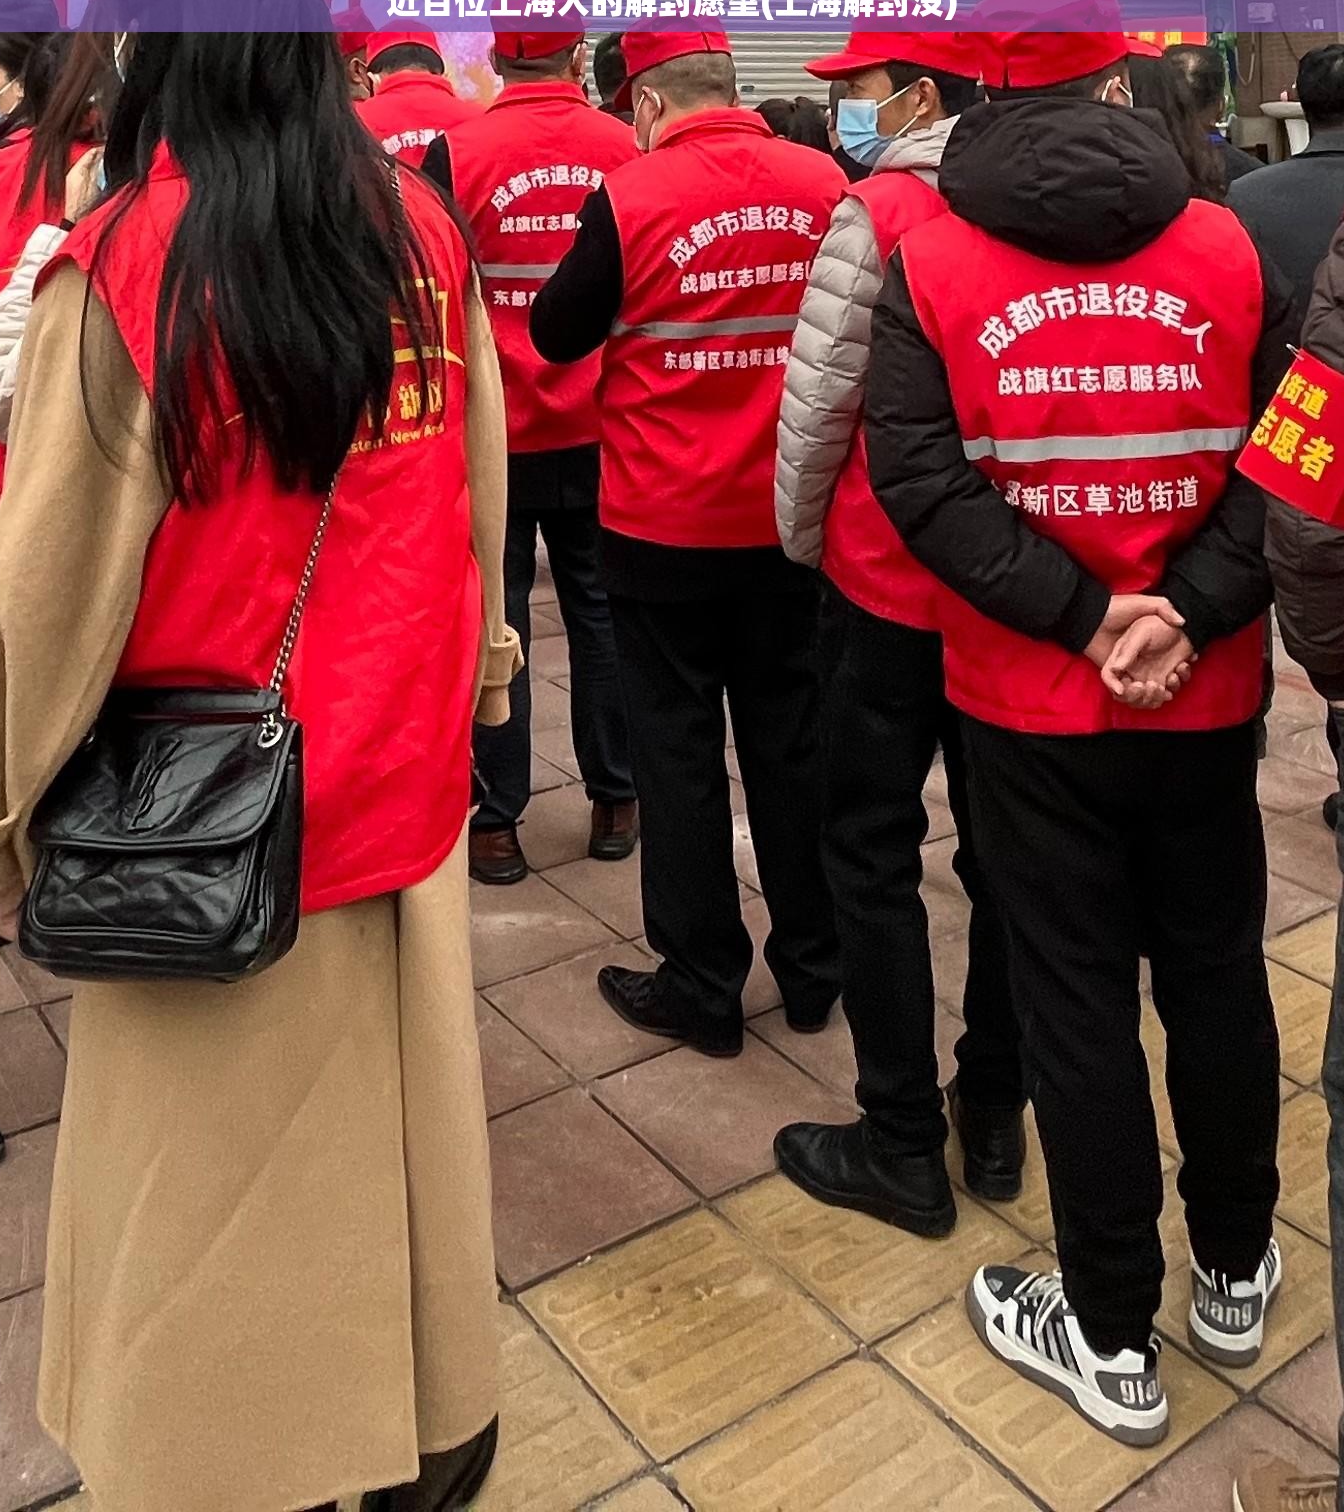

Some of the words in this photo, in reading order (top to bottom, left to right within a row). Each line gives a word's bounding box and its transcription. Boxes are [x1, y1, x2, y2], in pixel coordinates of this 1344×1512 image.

[381, 128, 445, 155] 都市退
[500, 213, 583, 233] 战旗红志愿
[977, 282, 1214, 359] 成都市退役军人
[998, 364, 1203, 396] 战旗红志愿服务队
[1276, 367, 1329, 421] 街道
[390, 430, 422, 445] New
[1251, 406, 1335, 482] 志愿者
[991, 475, 1199, 517] 部新区草池街道
